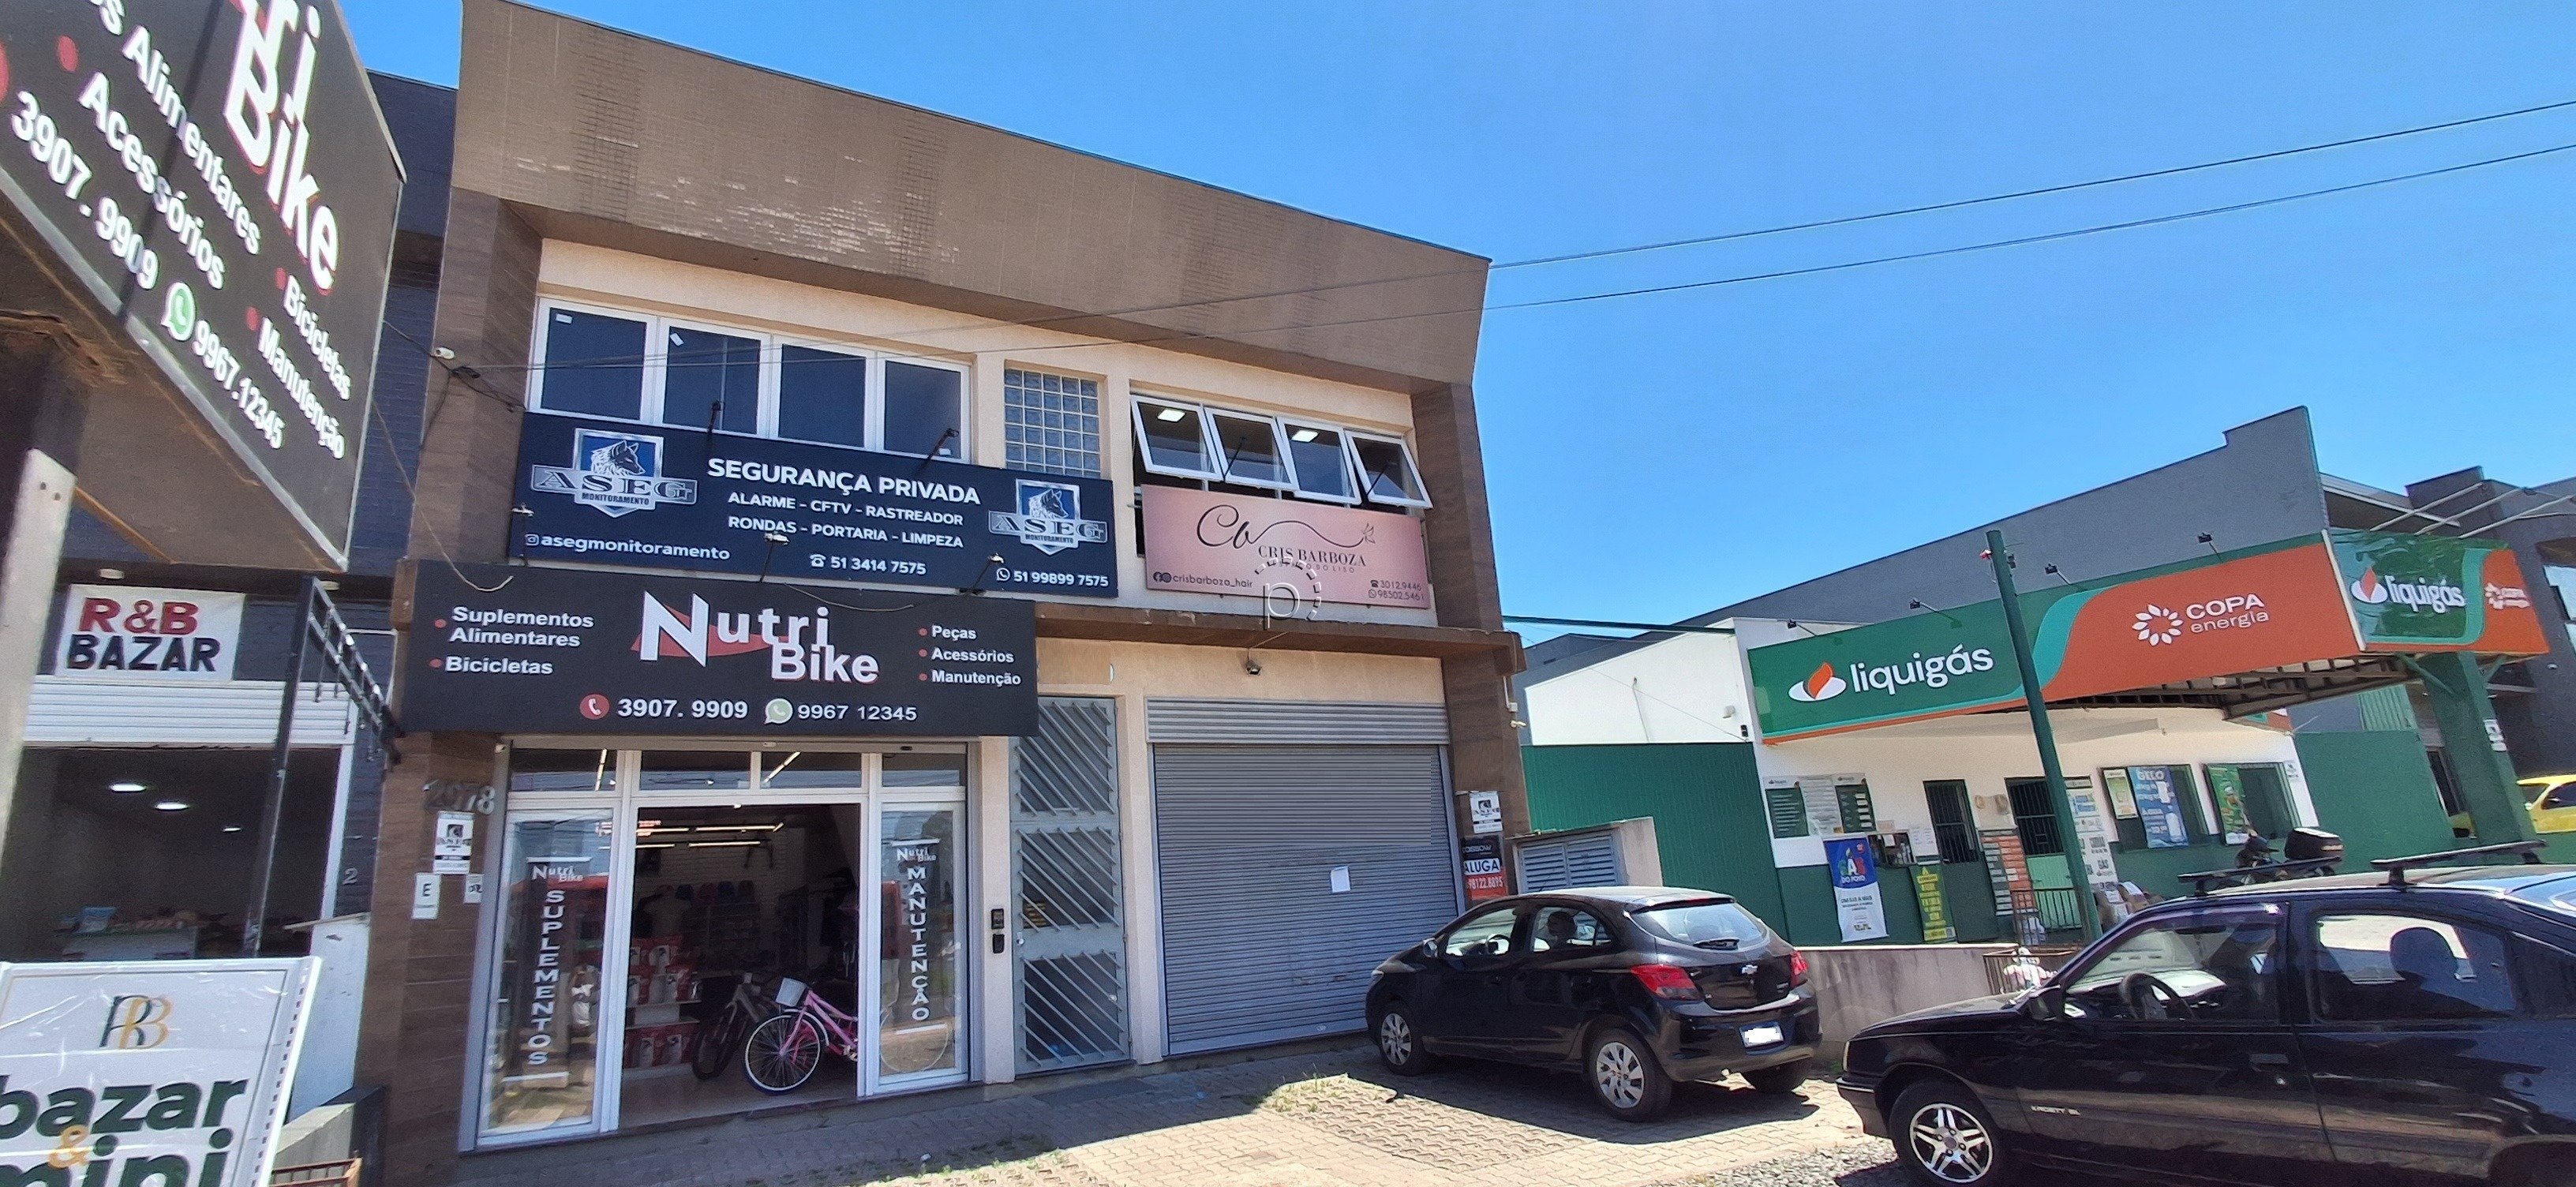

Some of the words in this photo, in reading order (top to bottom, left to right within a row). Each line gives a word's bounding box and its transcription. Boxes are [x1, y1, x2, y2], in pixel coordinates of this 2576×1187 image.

[122, 25, 260, 255] Alimentares
[79, 72, 226, 290] Acessórios
[223, 41, 339, 290] Bike
[95, 196, 159, 290] 9909
[282, 274, 351, 400] Bicicletas
[257, 317, 345, 459] Manutenção
[537, 470, 693, 500] ASEG
[707, 457, 872, 496] SEGURANÇA
[878, 477, 981, 505] PRIVADA
[582, 492, 650, 507] MONITORAMENTO
[728, 492, 796, 509] ALARME
[811, 500, 852, 515] CFTV
[865, 505, 964, 526] RASTREADOR
[541, 535, 731, 560] asegmonitoramento
[728, 516, 797, 534] RONDAS
[811, 524, 888, 541] PORTARIA
[901, 533, 964, 548] LIMPEZA
[831, 556, 847, 569] 51
[851, 559, 886, 572] 3414
[891, 561, 927, 575] 7575
[1258, 545, 1294, 558] CRIS
[1297, 549, 1366, 567] BARBOZA
[1013, 571, 1028, 582] 51
[1032, 572, 1074, 585] 99899
[1077, 575, 1108, 587] 7575
[1173, 574, 1253, 589] crisbarboza_hair
[2384, 574, 2467, 614] liquigás
[79, 597, 199, 635] R&B
[451, 606, 595, 628] Suplementos
[2185, 593, 2265, 620] COPA
[2191, 609, 2270, 633] energia
[449, 627, 581, 648] Alimentares
[640, 590, 830, 668] Nutri
[931, 625, 977, 642] Peças
[67, 634, 221, 672] BAZAR
[445, 656, 553, 675] Bicicletas
[770, 642, 880, 683] Bike
[931, 647, 1015, 663] Acessórios
[1849, 642, 1994, 695] liquigás
[931, 670, 1022, 687] Manutenção
[691, 701, 748, 719] 9909
[798, 705, 848, 720] 9967
[858, 706, 918, 721] 12345
[527, 889, 566, 1065] SUPLEMENTOS
[0, 1075, 250, 1140] bazar
[0, 1134, 234, 1187] mini
